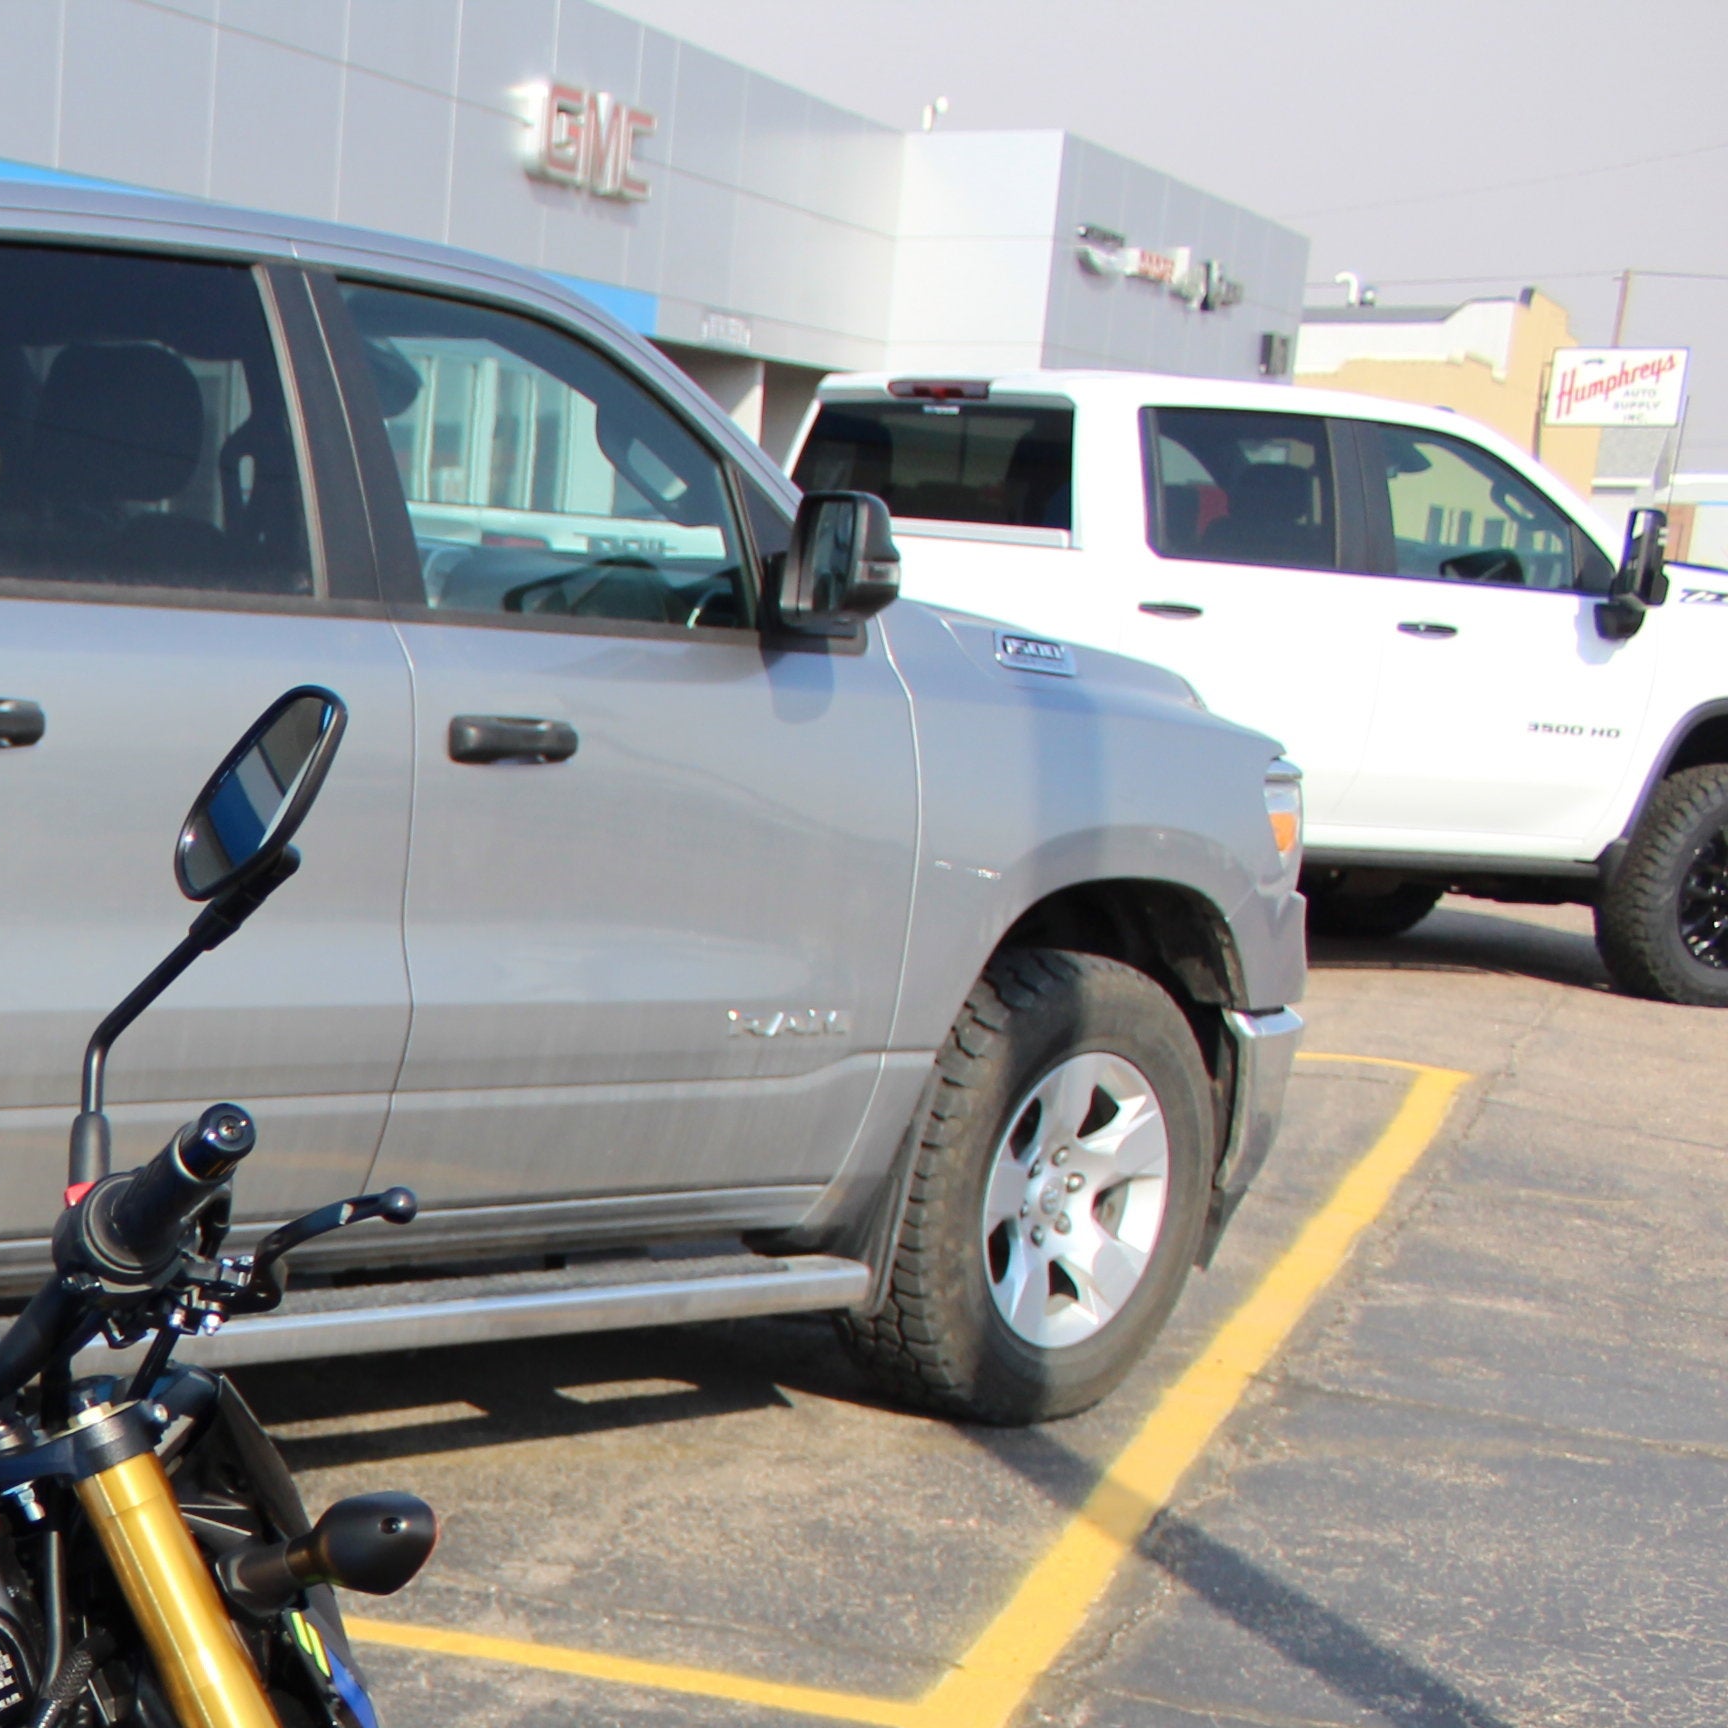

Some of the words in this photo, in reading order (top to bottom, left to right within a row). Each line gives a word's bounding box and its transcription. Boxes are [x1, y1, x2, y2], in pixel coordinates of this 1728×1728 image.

[538, 82, 658, 201] GMC
[1556, 353, 1676, 419] Humphreys
[1623, 388, 1657, 398] AUTO
[1527, 721, 1584, 737] 3500
[1591, 726, 1620, 739] HD
